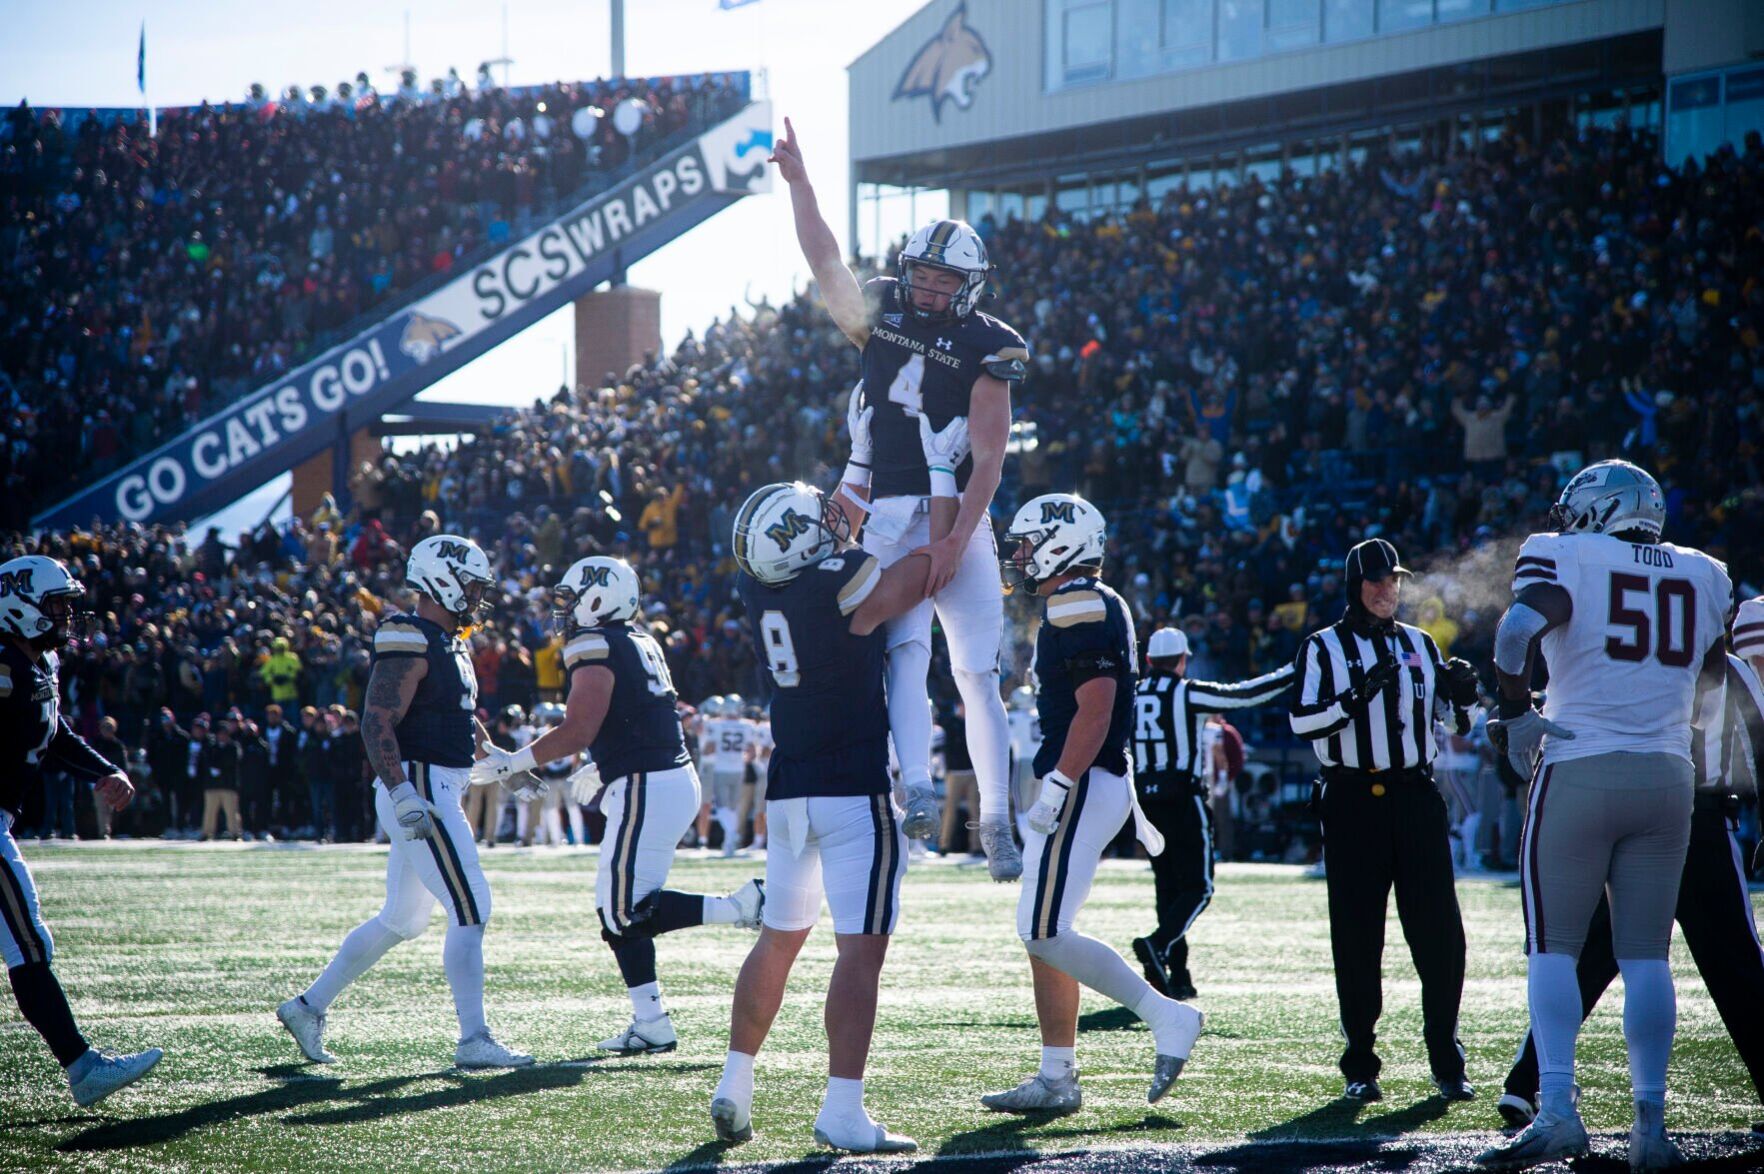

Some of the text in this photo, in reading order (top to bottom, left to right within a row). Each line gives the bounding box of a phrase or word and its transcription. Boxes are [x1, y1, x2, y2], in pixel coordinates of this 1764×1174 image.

[473, 155, 704, 320] SCS WRAPS
[871, 326, 961, 370] MONTANA STATE
[887, 352, 926, 412] 4
[115, 338, 391, 521] GO CATS GO!
[764, 506, 810, 554] M
[1040, 501, 1076, 524] M
[436, 540, 471, 565] M
[1631, 544, 1674, 569] TODD
[0, 568, 35, 598] M
[579, 565, 611, 588] M
[1605, 570, 1697, 668] 50
[759, 609, 801, 689] 8
[1413, 682, 1424, 699] U
[1134, 694, 1166, 740] R
[721, 732, 744, 753] 52
